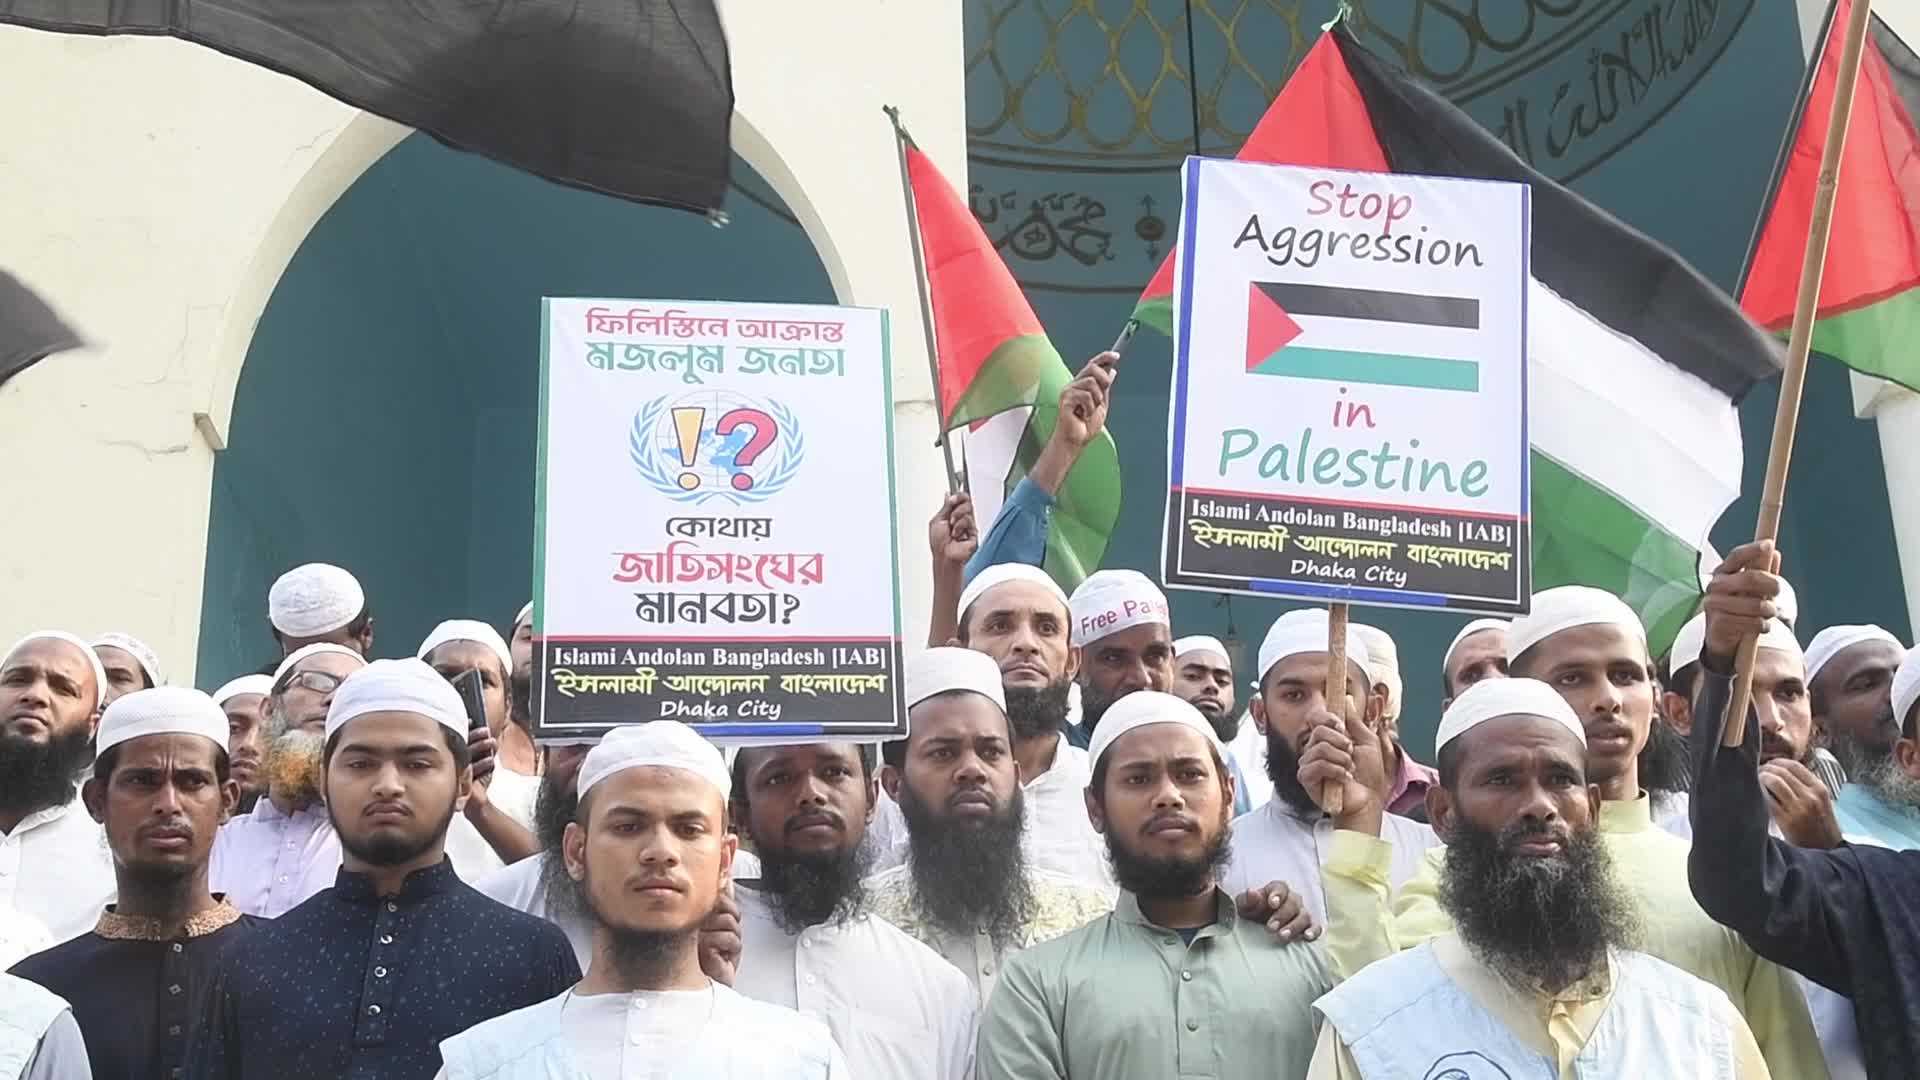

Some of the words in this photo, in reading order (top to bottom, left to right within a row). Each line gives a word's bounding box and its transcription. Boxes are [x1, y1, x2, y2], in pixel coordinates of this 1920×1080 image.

[1307, 180, 1412, 235] Stop
[1233, 214, 1483, 268] Aggression
[736, 319, 844, 342] আক্রান্ত
[585, 341, 724, 384] মজলুম
[736, 347, 846, 376] জনতা
[1332, 386, 1376, 429] in
[1218, 427, 1489, 498] Palestine
[665, 517, 772, 541] কোথায়
[1191, 499, 1250, 521] Islami
[1255, 505, 1336, 528] Andolan
[1342, 512, 1452, 538] Bangladesh
[1188, 519, 1289, 553] ইসলামী
[1293, 535, 1398, 561] আন্দোলন
[1407, 543, 1512, 571] বাংলাদেশ
[611, 540, 824, 589] জাতিসংঘের
[1290, 560, 1356, 580] Dhaka
[1364, 566, 1408, 588] City
[634, 592, 801, 625] মানবতা?
[1080, 610, 1117, 636] Free
[553, 647, 615, 666] Islami
[622, 648, 706, 666] Andolan
[712, 648, 825, 671] Bangladesh
[551, 667, 658, 696] ইসলামী
[662, 674, 770, 696] আন্দোলন
[780, 674, 887, 696] বাংলাদেশ
[660, 700, 728, 718] Dhaka
[736, 701, 782, 720] City
